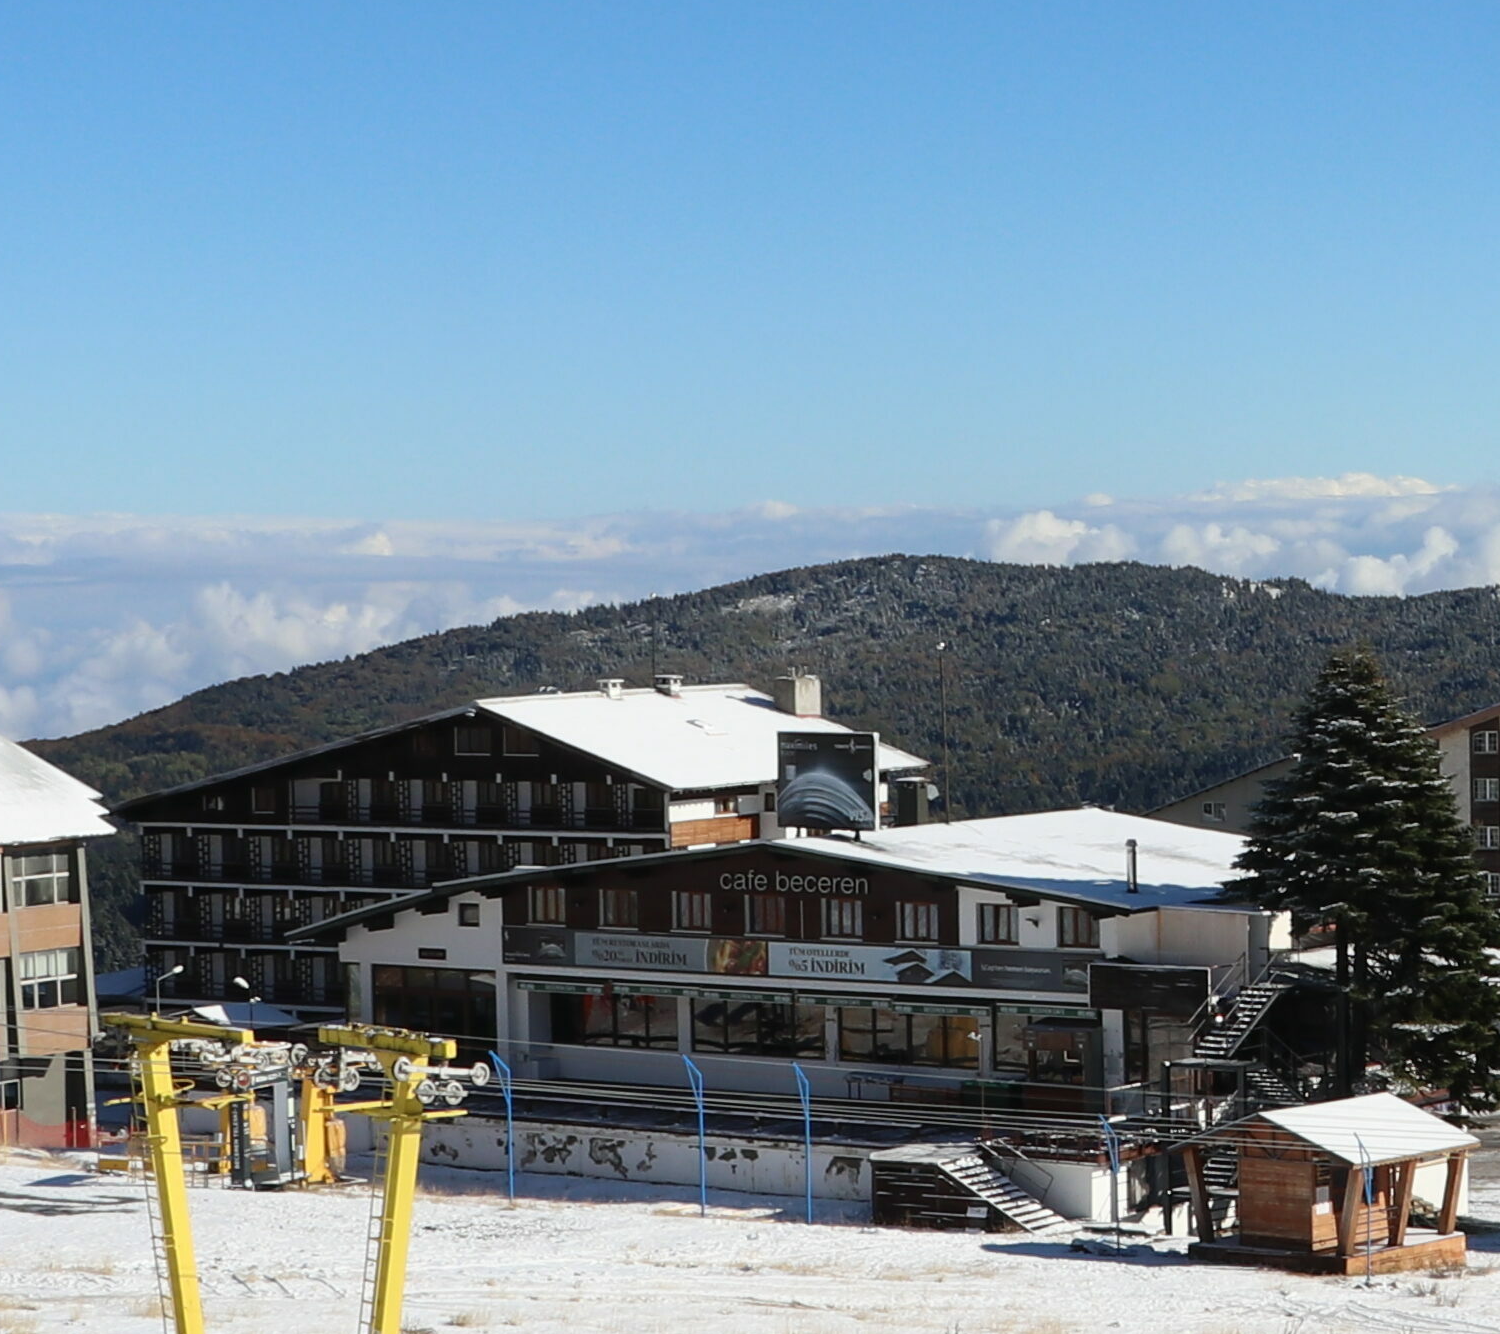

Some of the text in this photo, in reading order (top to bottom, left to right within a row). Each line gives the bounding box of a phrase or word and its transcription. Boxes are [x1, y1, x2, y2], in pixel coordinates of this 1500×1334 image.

[719, 870, 869, 895] cafe beceren
[635, 948, 687, 965] İNDİRİM
[811, 957, 865, 975] İNDİRİM
